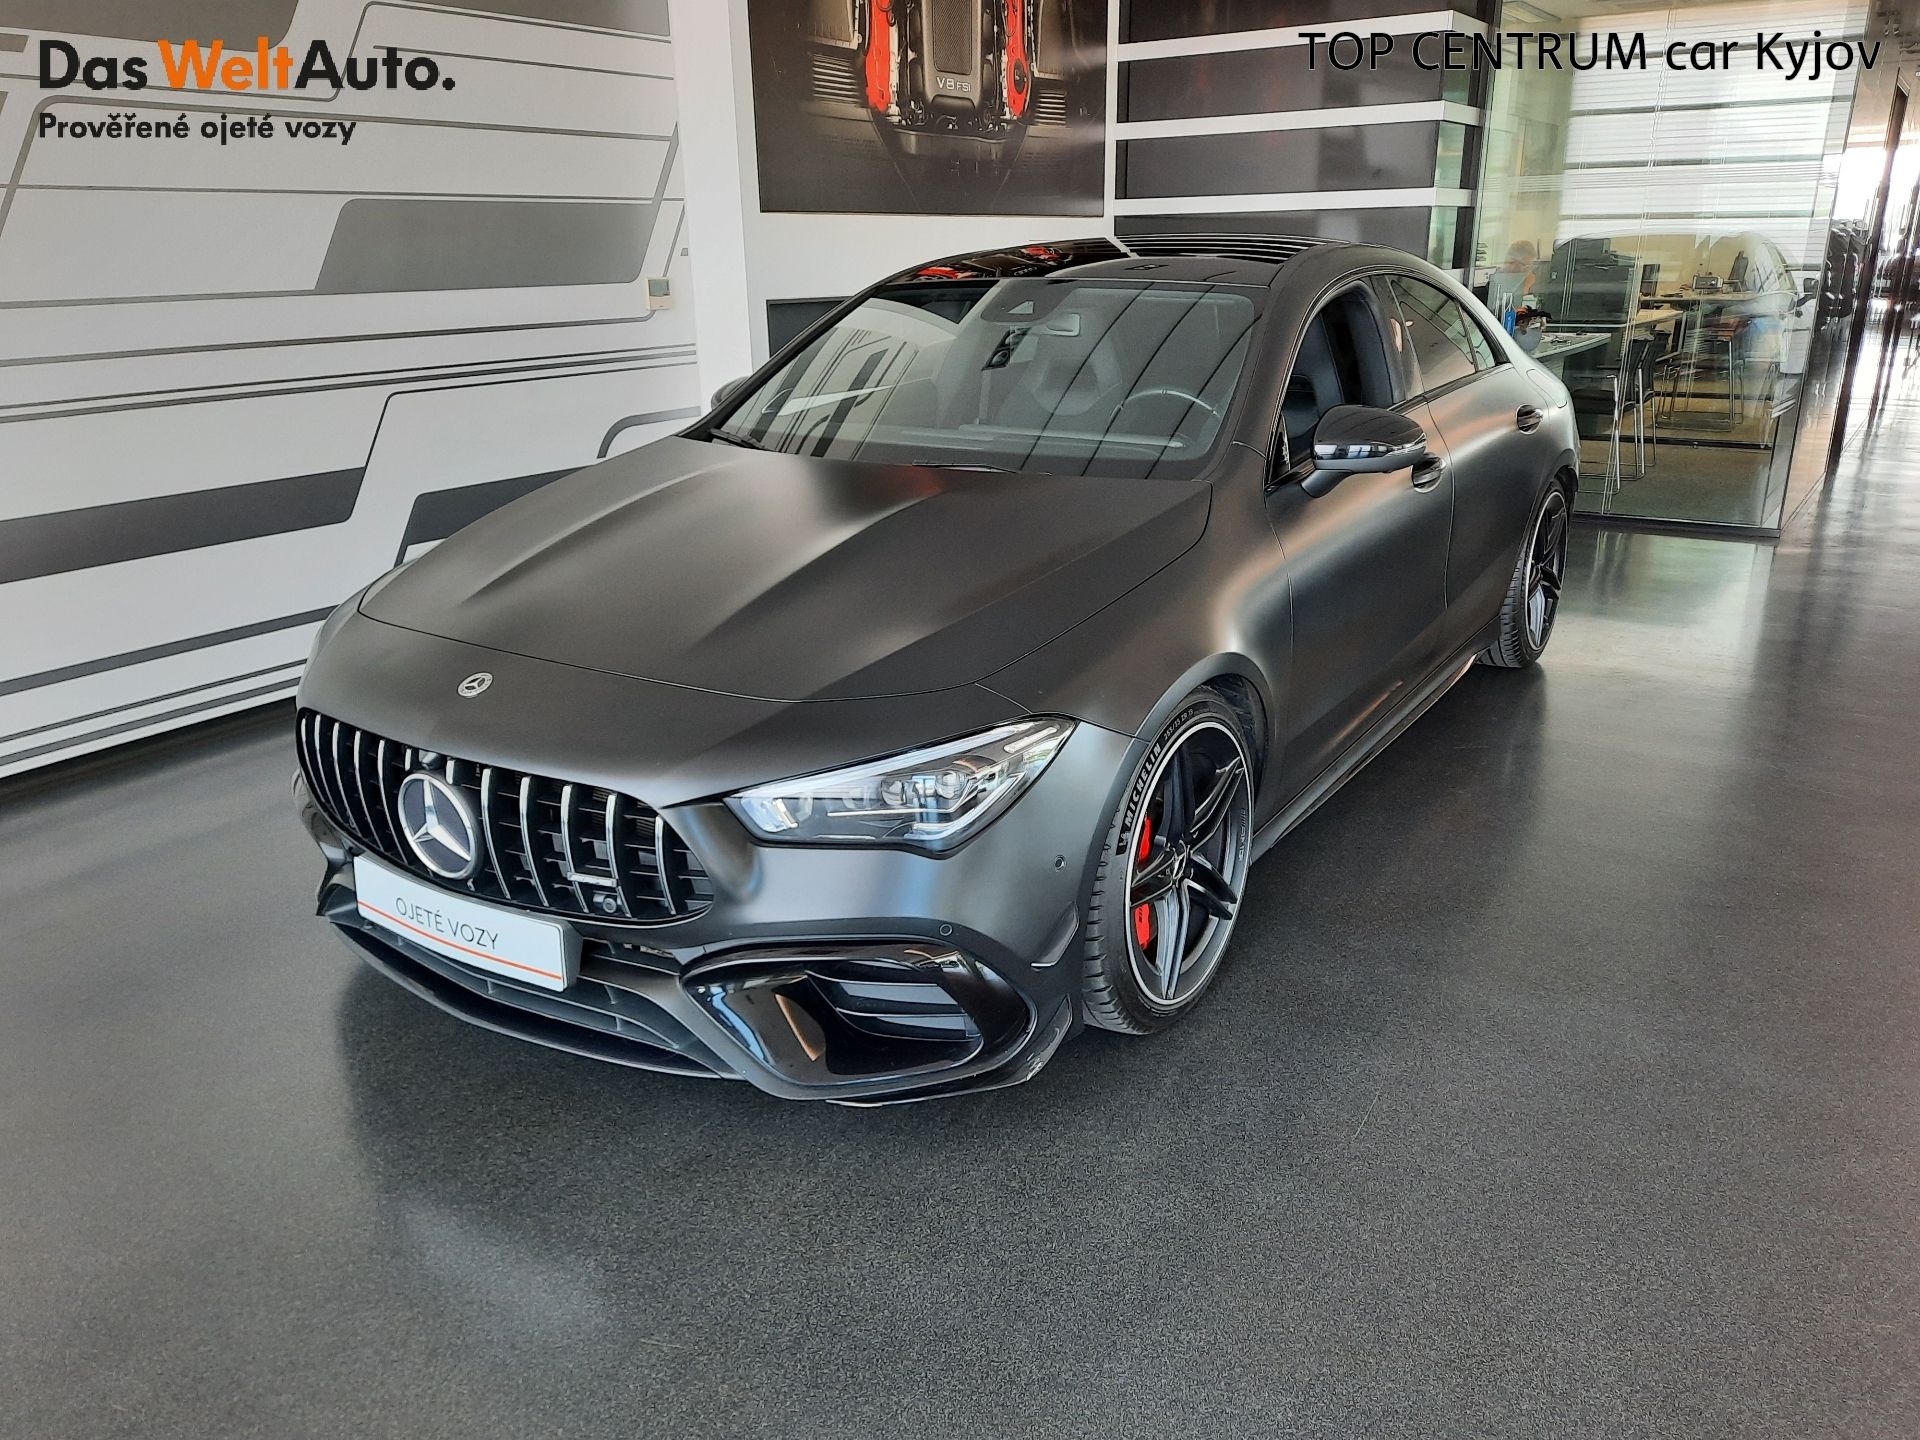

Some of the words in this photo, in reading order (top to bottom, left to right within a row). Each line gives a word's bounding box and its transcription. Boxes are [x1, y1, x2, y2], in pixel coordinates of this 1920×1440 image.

[936, 76, 955, 90] V8
[1125, 742, 1162, 828] MICHELIN
[395, 897, 445, 933] OJETÉ
[447, 918, 499, 950] VOZY
